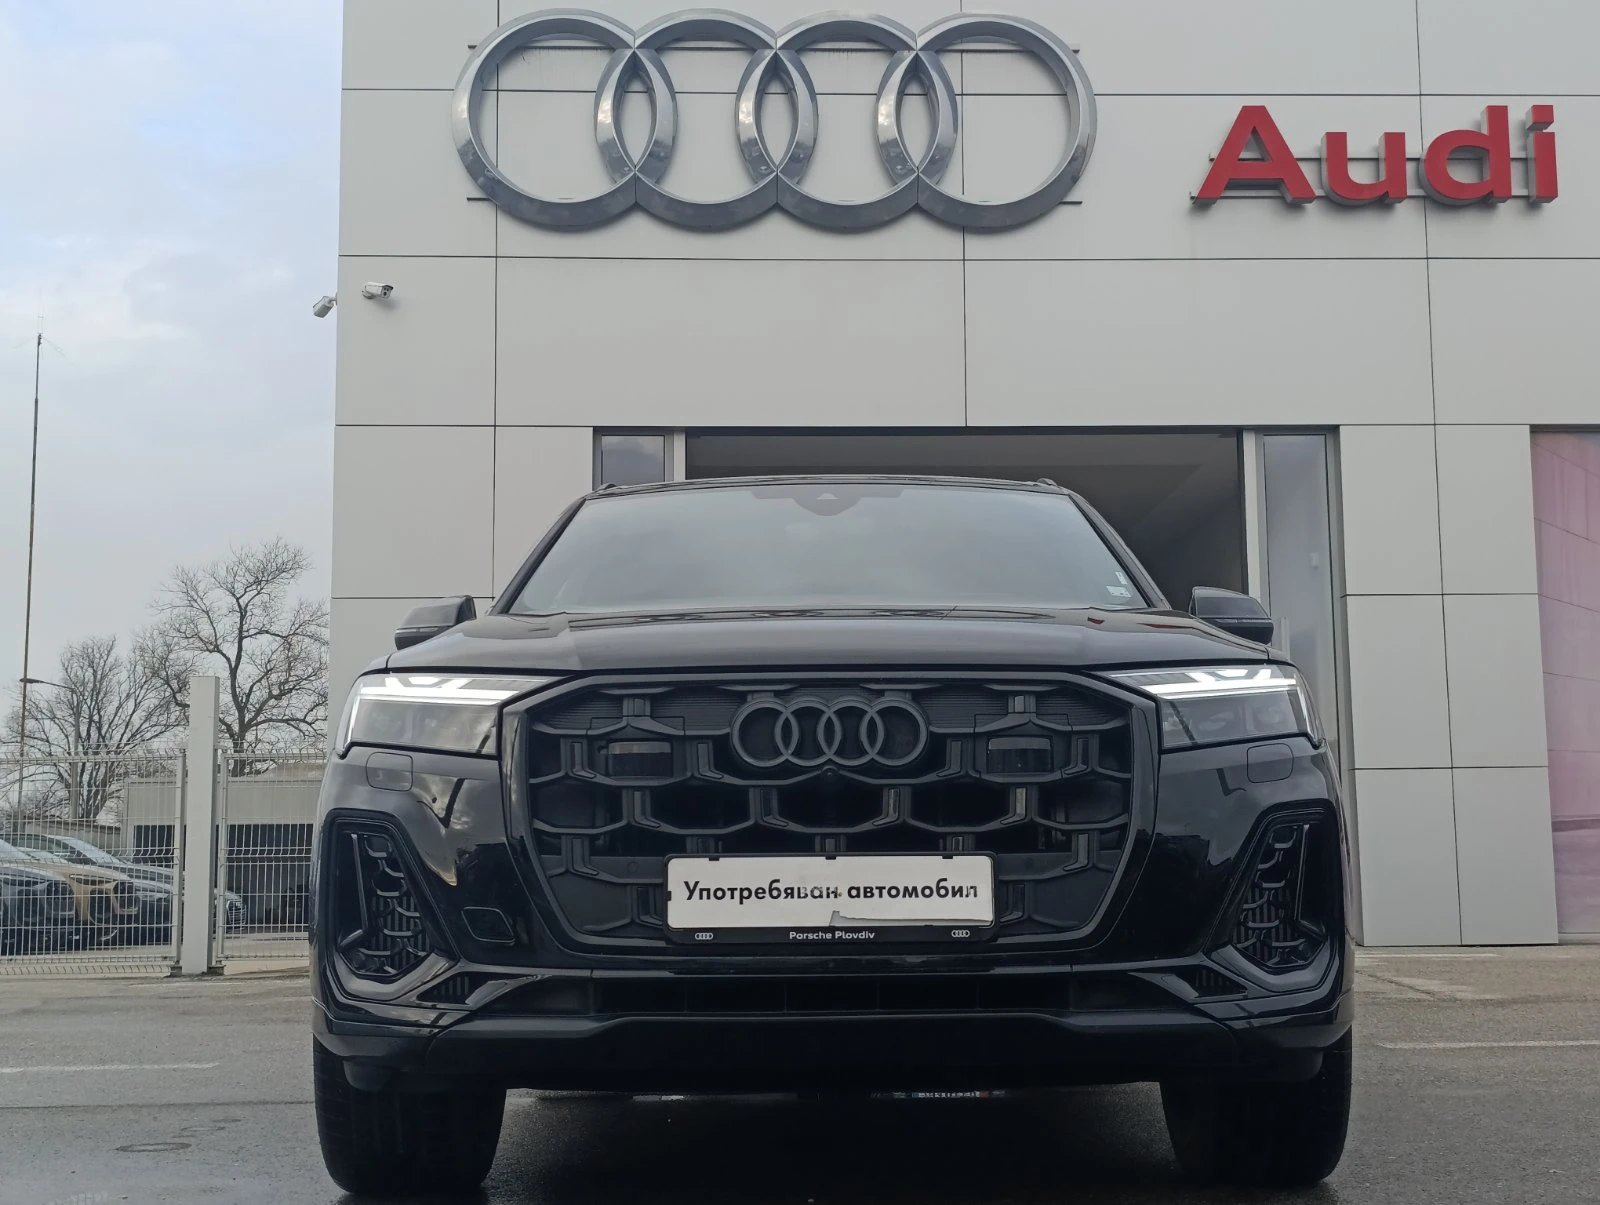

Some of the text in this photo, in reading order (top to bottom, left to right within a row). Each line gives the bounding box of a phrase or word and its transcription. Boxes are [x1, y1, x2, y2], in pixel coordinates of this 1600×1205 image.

[1193, 104, 1559, 204] Audi
[683, 878, 979, 905] Употребяван автомобил
[789, 930, 876, 940] Porsche Plovdiv
